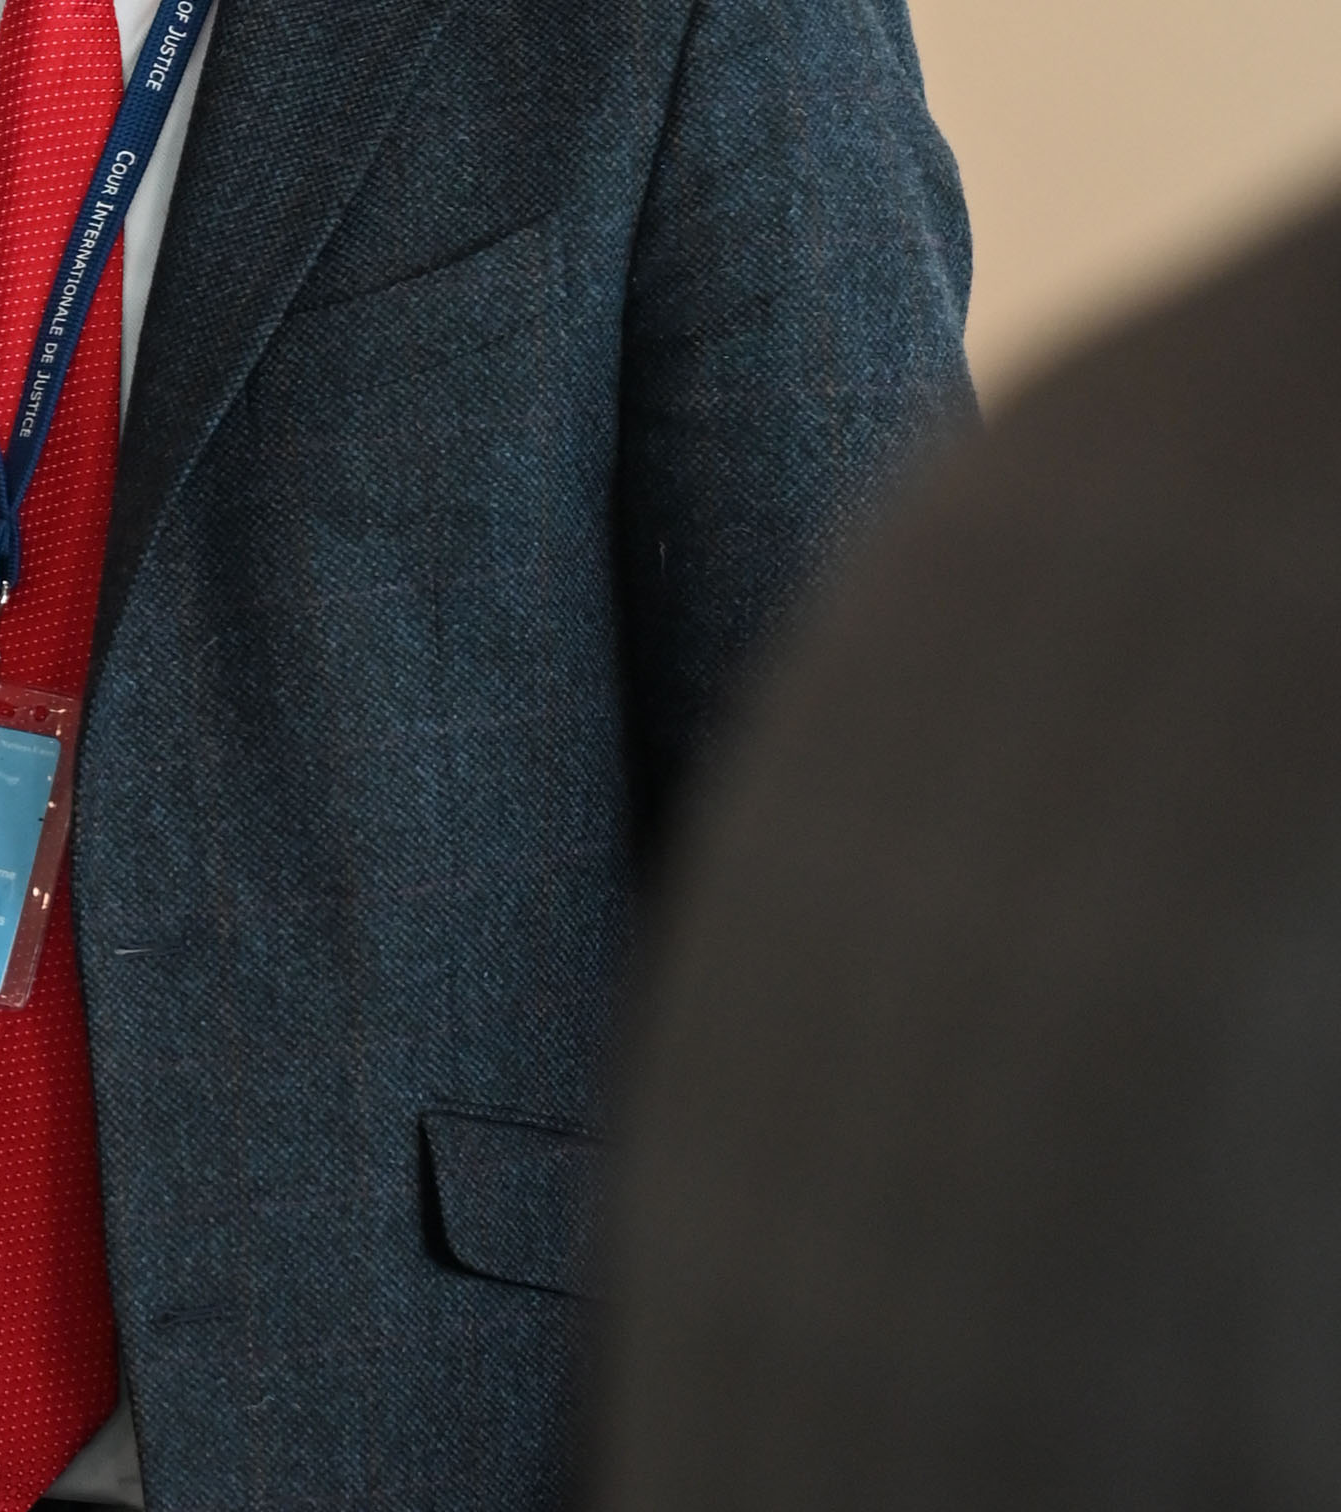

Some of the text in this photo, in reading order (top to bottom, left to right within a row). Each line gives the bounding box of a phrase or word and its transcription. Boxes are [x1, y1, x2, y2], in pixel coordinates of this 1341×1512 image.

[175, 1, 193, 24] OF
[145, 25, 187, 92] JUSTICE
[19, 150, 136, 438] COUR INTERNATIONALE DE JUSTICE
